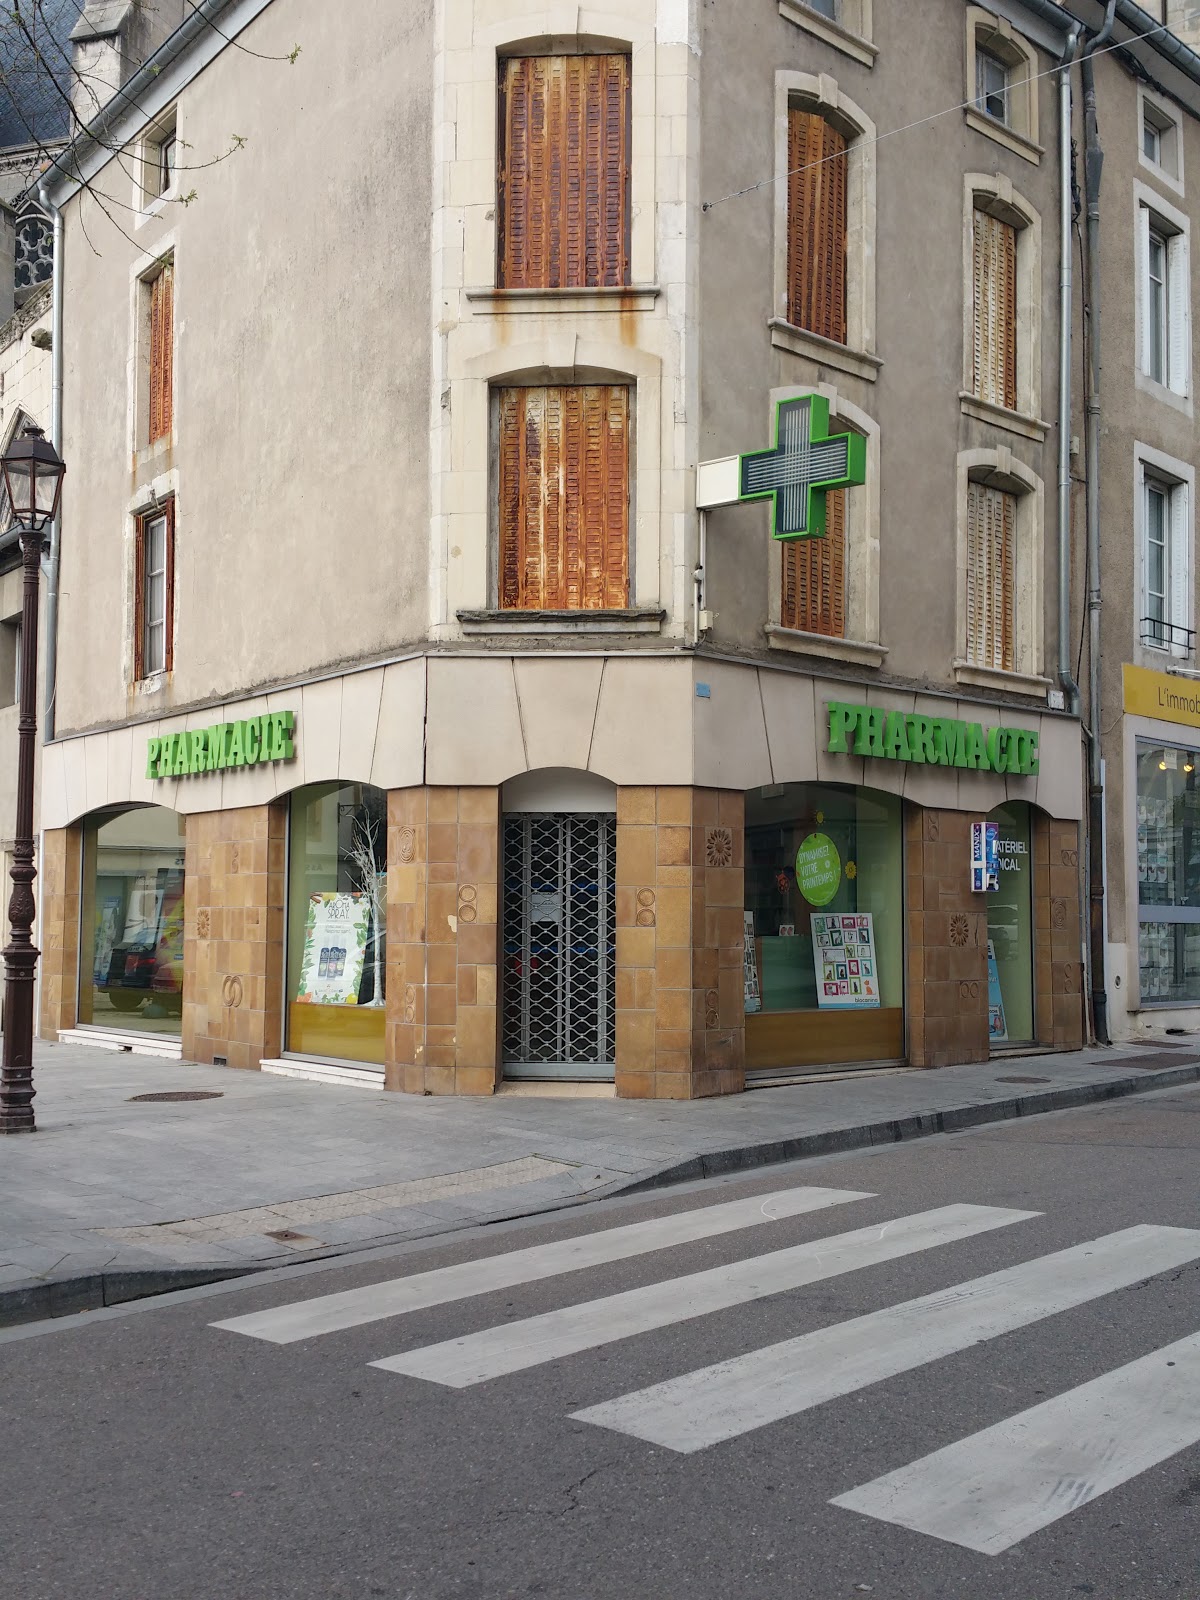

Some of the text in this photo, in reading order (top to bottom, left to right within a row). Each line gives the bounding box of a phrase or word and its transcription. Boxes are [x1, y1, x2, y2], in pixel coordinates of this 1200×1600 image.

[145, 711, 294, 779] PHARMACIE
[828, 701, 1039, 776] PHARMACIE
[799, 845, 829, 864] DYNAMISEZ
[996, 837, 1028, 853] ATÉRIEL
[800, 862, 818, 877] VOTRE
[802, 871, 833, 890] PRINTEMPS
[329, 899, 350, 909] AROMA
